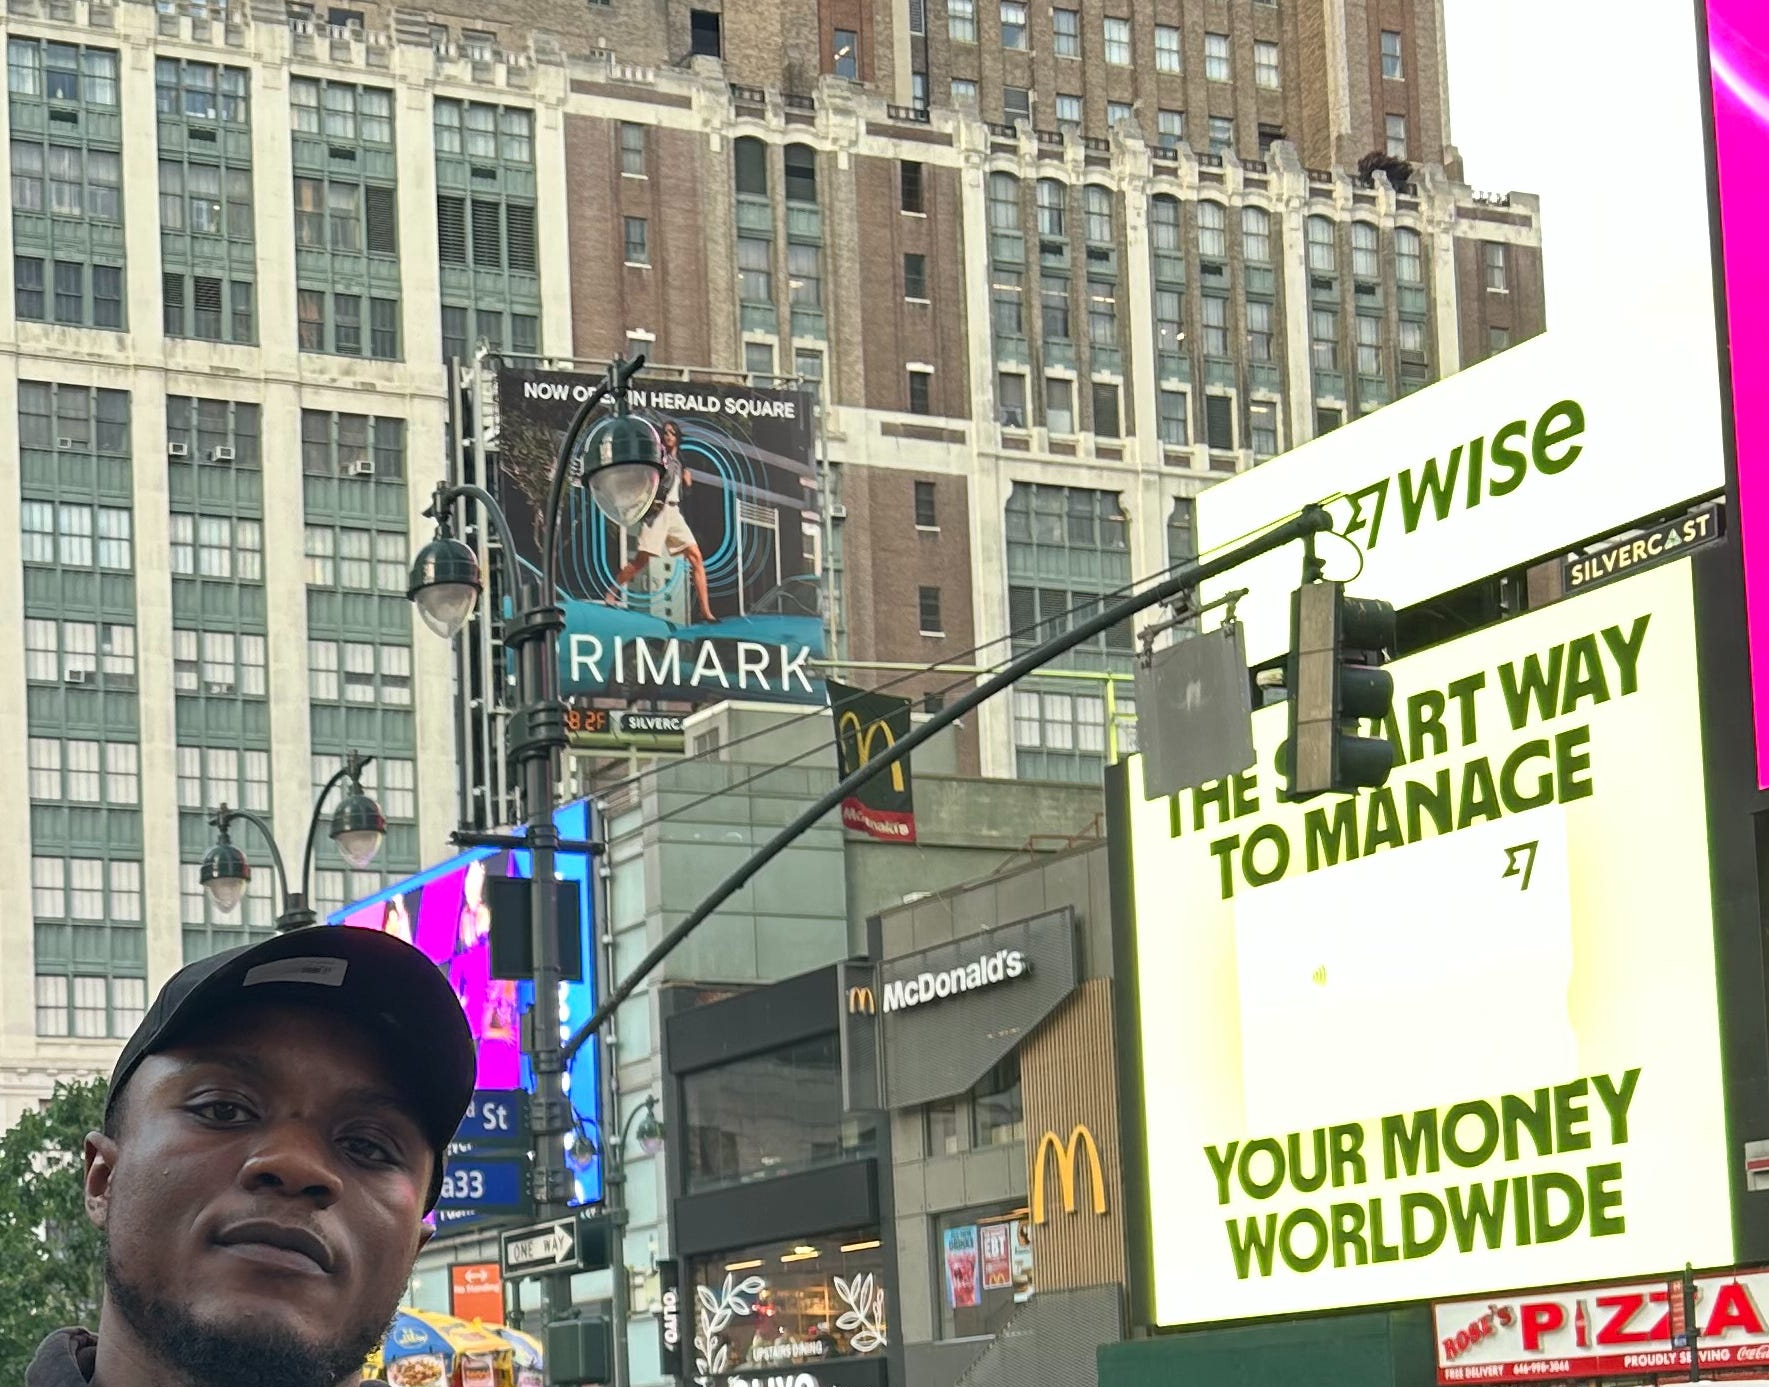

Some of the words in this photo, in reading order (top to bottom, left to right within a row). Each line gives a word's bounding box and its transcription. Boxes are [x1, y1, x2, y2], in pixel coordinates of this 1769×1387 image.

[523, 382, 569, 401] NOW
[628, 390, 647, 408] IN
[651, 391, 721, 413] HERALD
[724, 398, 795, 419] SQUARE
[556, 633, 814, 694] RIMARK
[1498, 613, 1652, 731] WAY
[628, 716, 684, 732] SILVERC
[1211, 822, 1290, 901] TO
[1304, 724, 1594, 873] MANAGE
[883, 949, 1024, 1014] McDonald's
[482, 1102, 508, 1131] St
[1203, 1121, 1367, 1205] YOUR
[1380, 1067, 1642, 1181] MONEY
[513, 1240, 533, 1262] ONE
[543, 1234, 565, 1254] WAY
[1225, 1161, 1627, 1280] WORLDWIDE
[1442, 1304, 1516, 1362] ROSE'S
[1624, 1351, 1677, 1368] PROUDLY
[1679, 1348, 1731, 1365] SEVING
[1465, 1364, 1504, 1380] DELIVERY
